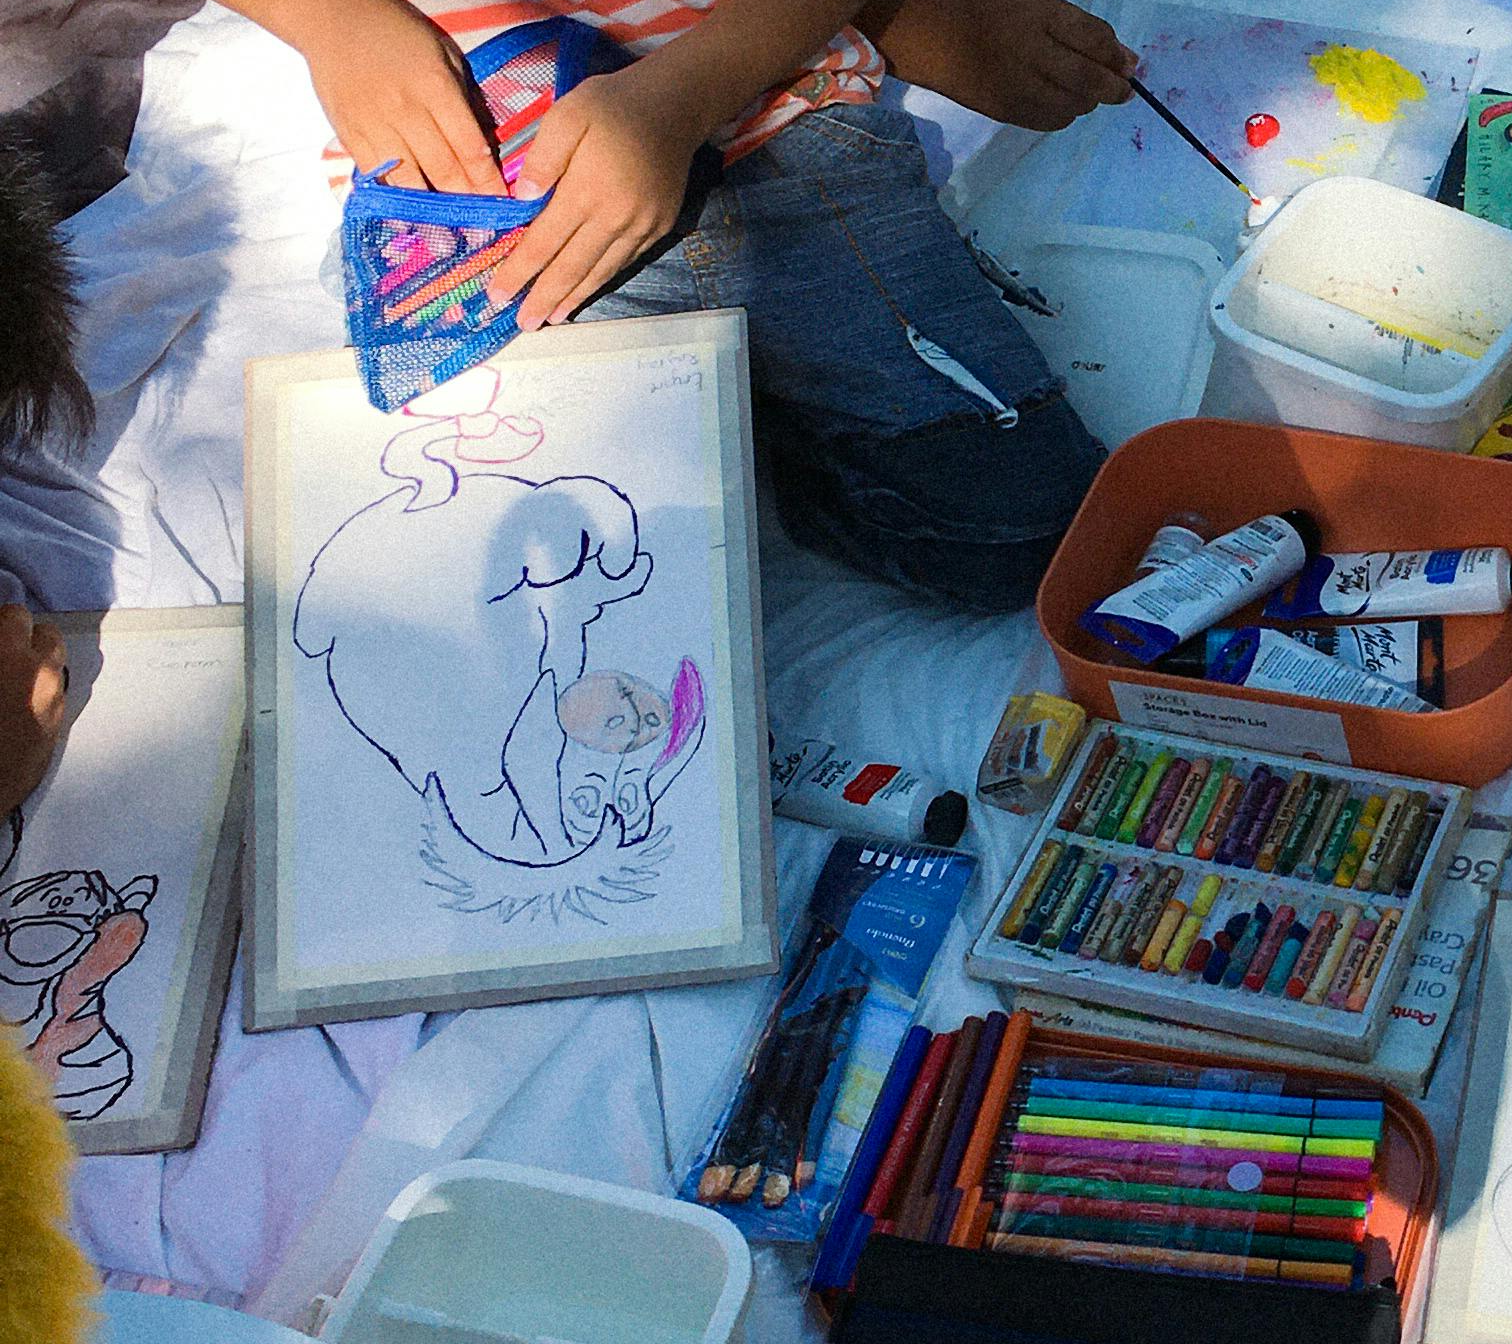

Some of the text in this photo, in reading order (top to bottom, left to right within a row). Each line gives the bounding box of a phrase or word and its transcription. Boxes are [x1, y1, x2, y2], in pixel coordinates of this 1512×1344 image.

[1375, 625, 1401, 665] Mont
[1144, 702, 1268, 730] Storage Box with Lid
[1447, 855, 1496, 884] 36
[909, 914, 926, 927] 6
[1415, 982, 1446, 997] Oil
